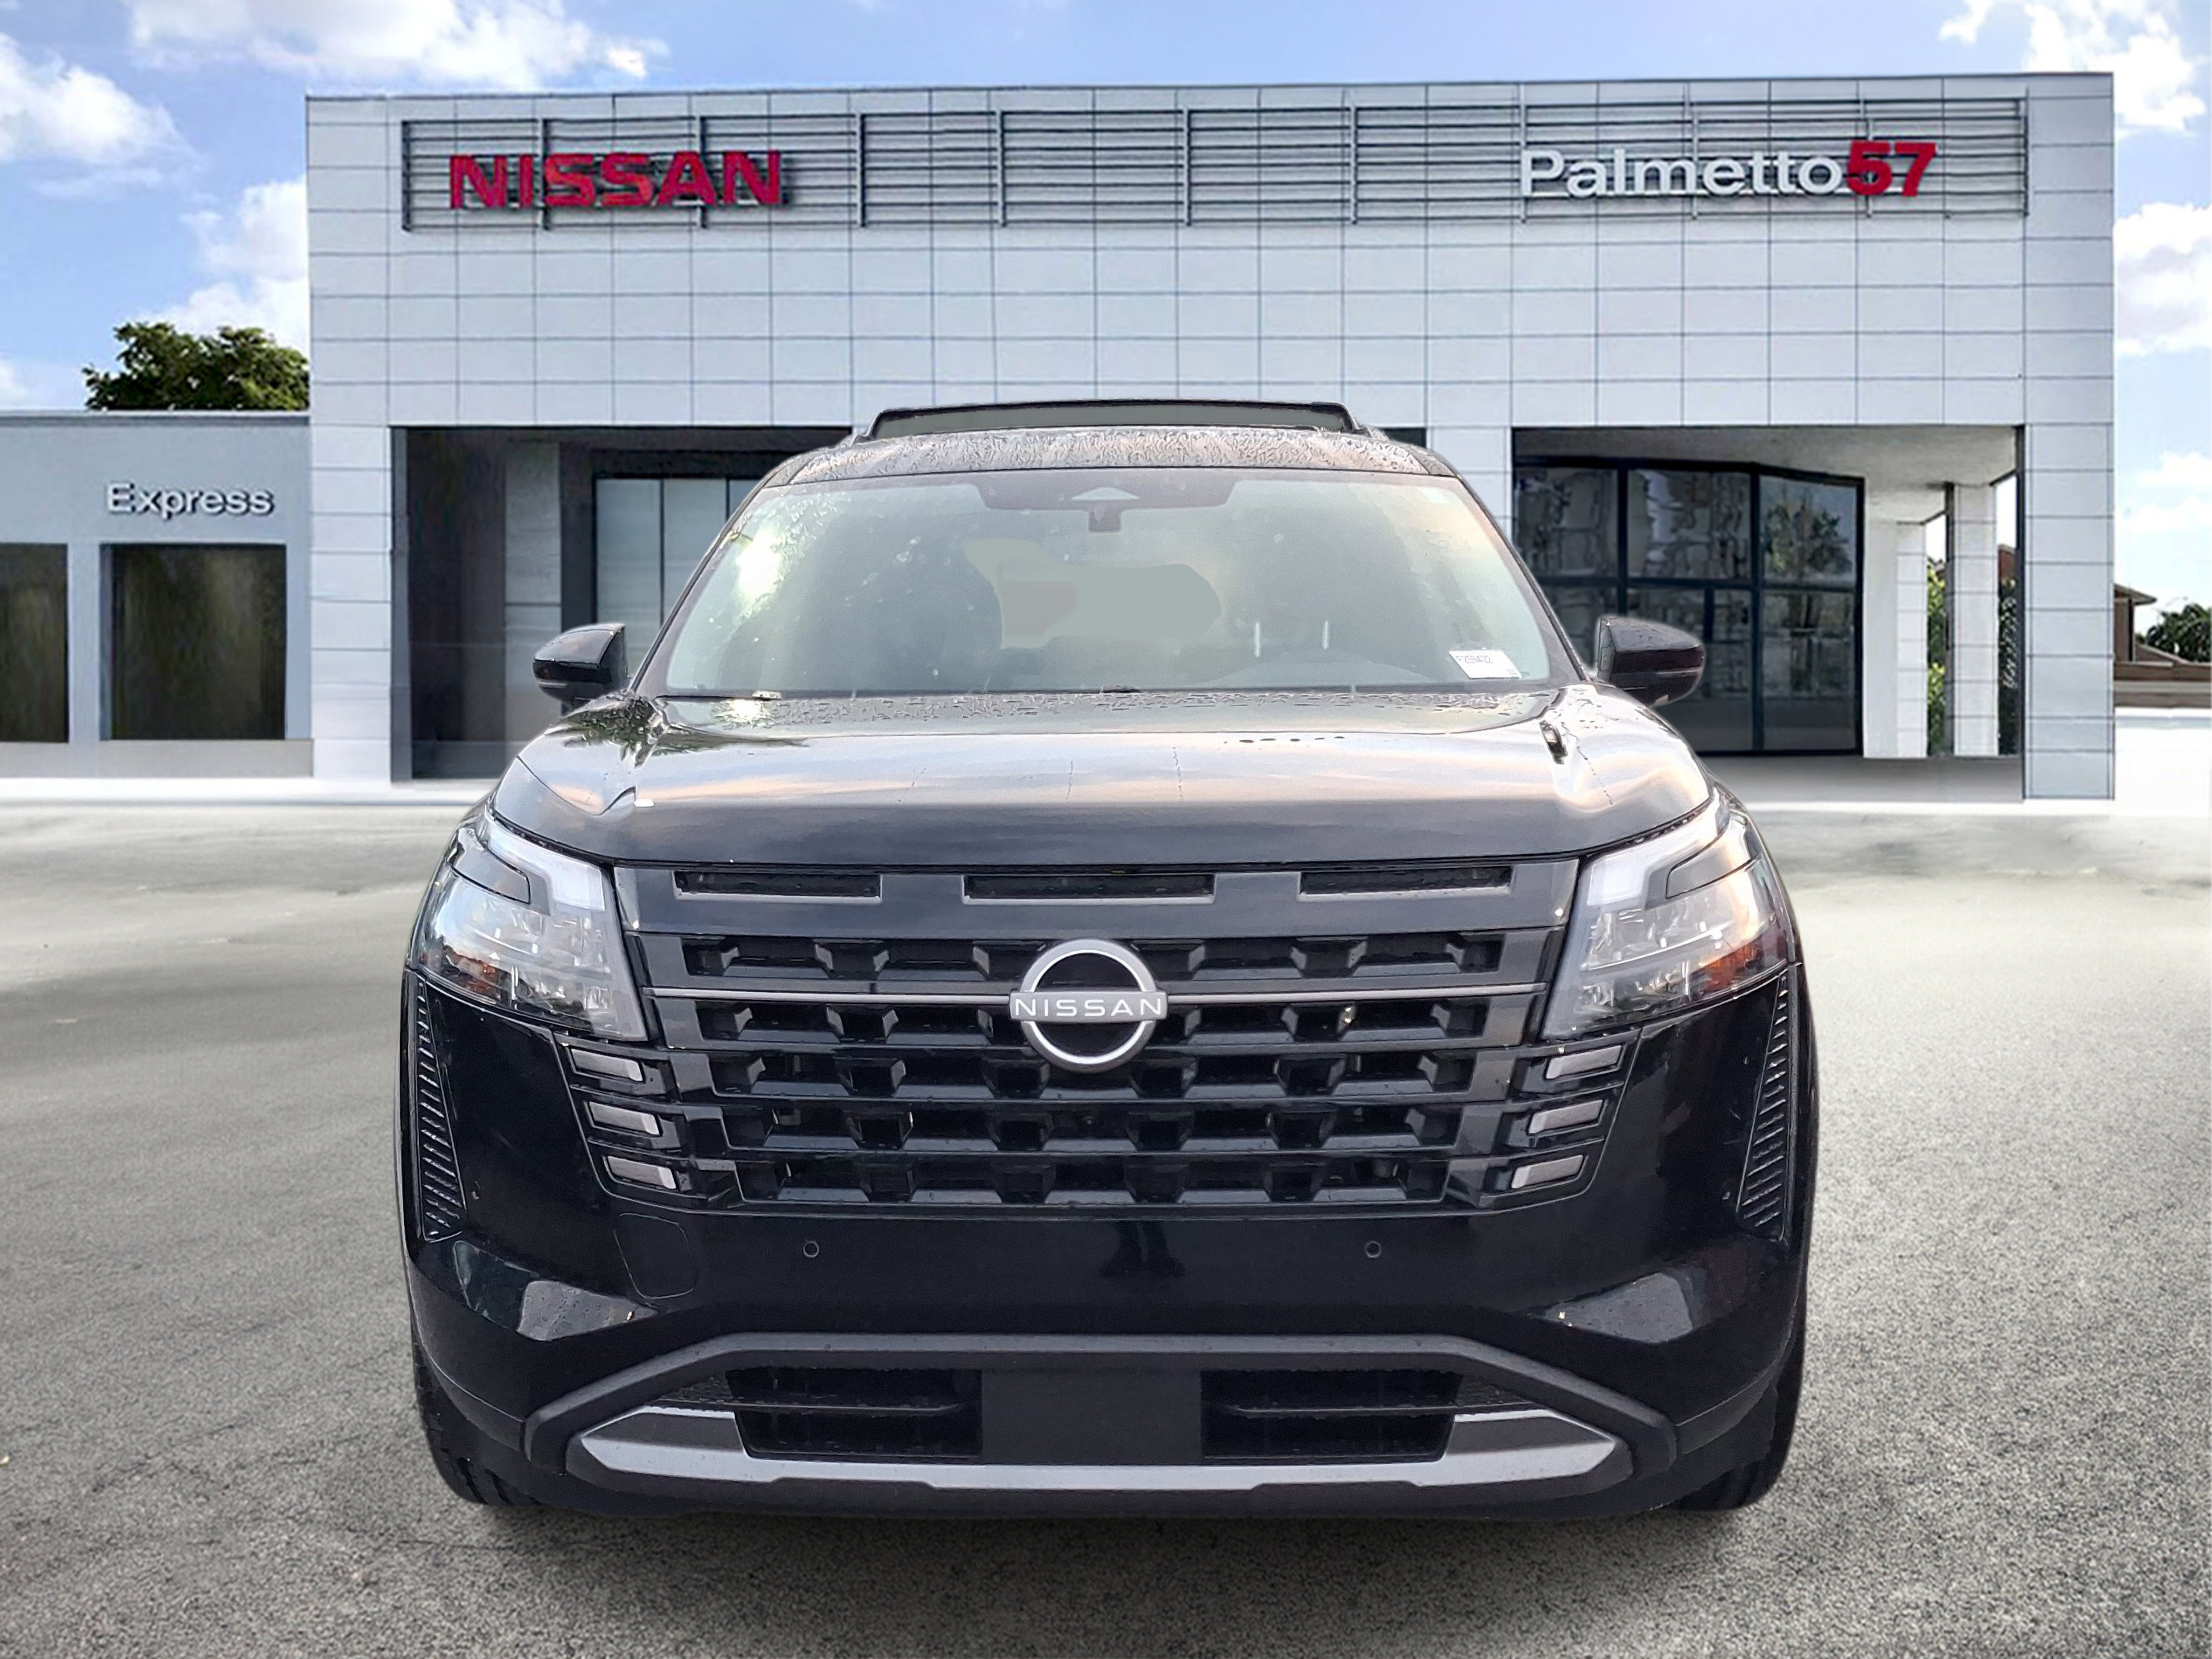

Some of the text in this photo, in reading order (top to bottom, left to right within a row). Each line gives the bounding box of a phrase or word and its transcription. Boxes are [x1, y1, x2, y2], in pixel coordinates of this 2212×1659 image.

[449, 150, 782, 209] NISSAN
[107, 481, 275, 520] Express
[1015, 998, 1161, 1016] NISSAN
